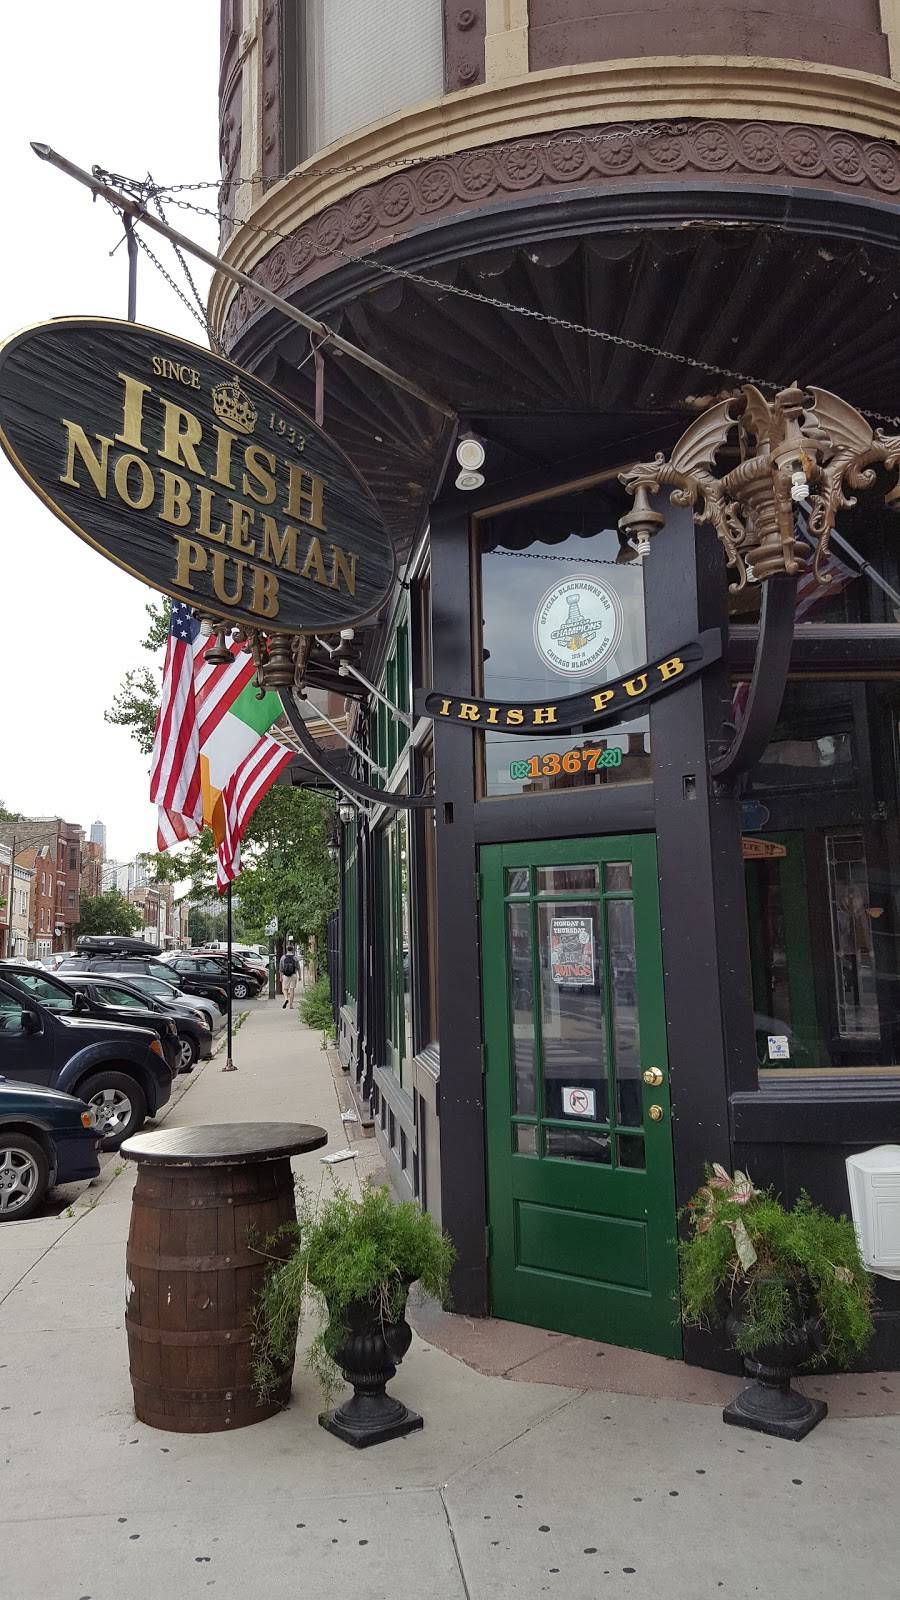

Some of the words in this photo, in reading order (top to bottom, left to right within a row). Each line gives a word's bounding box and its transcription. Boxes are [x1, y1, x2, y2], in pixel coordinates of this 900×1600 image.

[153, 356, 200, 390] SINCE
[269, 412, 307, 455] 1933
[115, 372, 328, 532] IRISH
[60, 419, 359, 597] NOBLEMAN
[171, 534, 280, 618] PUB
[541, 594, 559, 625] OFFICIAL
[558, 582, 602, 596] BLACKHAWKS
[600, 594, 611, 611] BAR
[546, 648, 570, 669] CHICAGO
[571, 637, 610, 669] BLACKHAWKS
[551, 620, 602, 640] CHAMPIONS
[439, 698, 558, 725] IRISH
[590, 656, 685, 712] PUB
[527, 748, 602, 778] 1367
